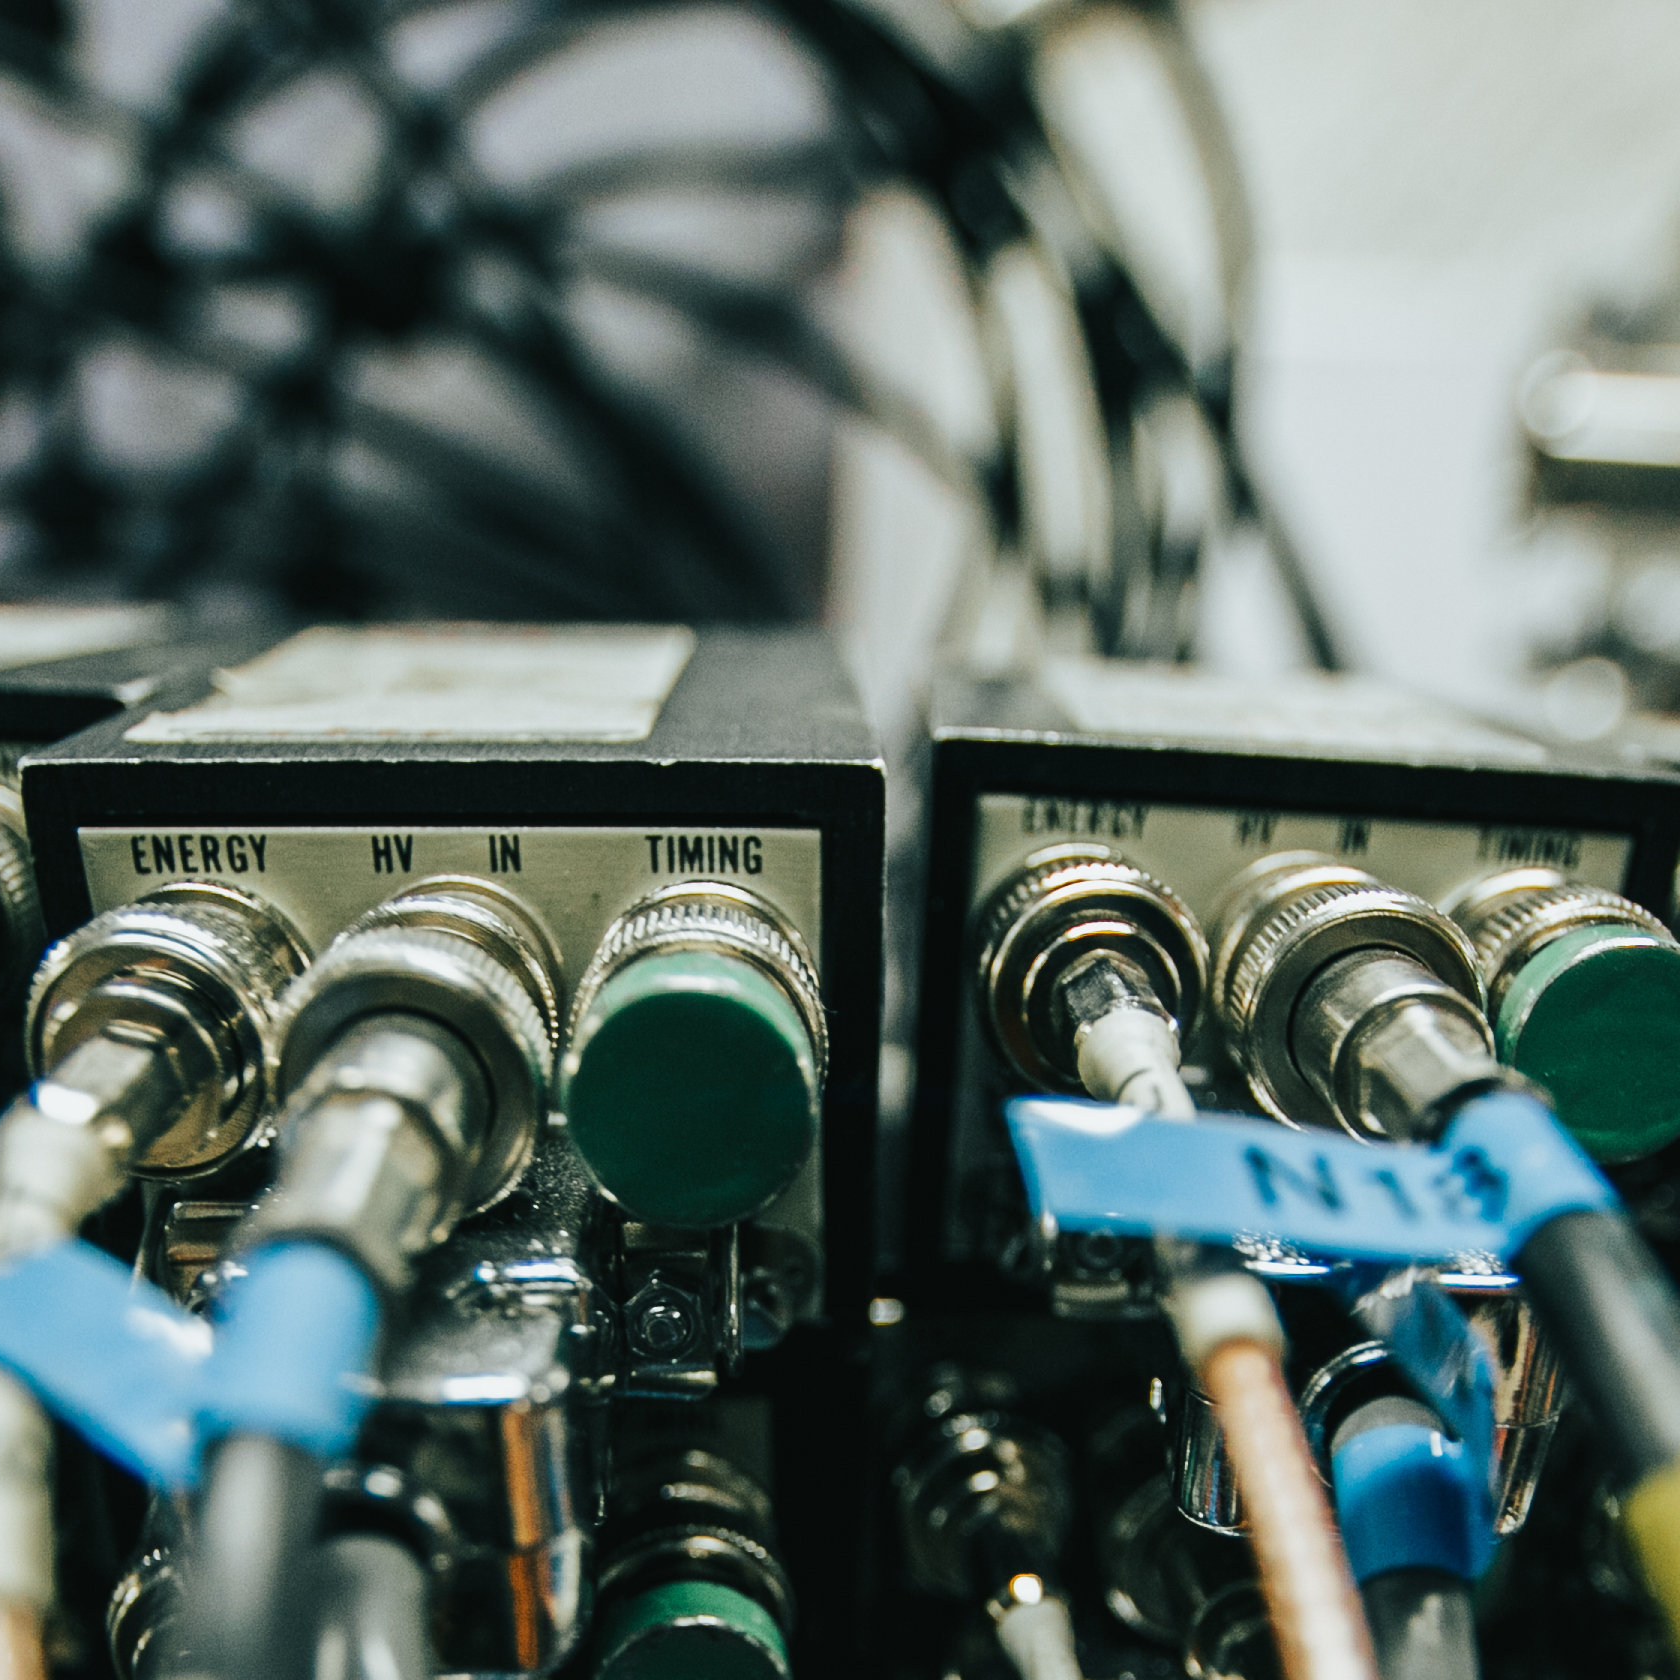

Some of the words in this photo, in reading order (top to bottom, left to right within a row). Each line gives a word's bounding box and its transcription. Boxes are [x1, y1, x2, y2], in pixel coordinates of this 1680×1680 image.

[131, 834, 268, 875] ENERGY
[372, 835, 414, 874] HV
[488, 835, 522, 874] IN
[646, 834, 763, 875] TIMING
[1022, 802, 1148, 841] ENERGY
[1337, 818, 1370, 856] IN
[1477, 826, 1581, 868] TIMING
